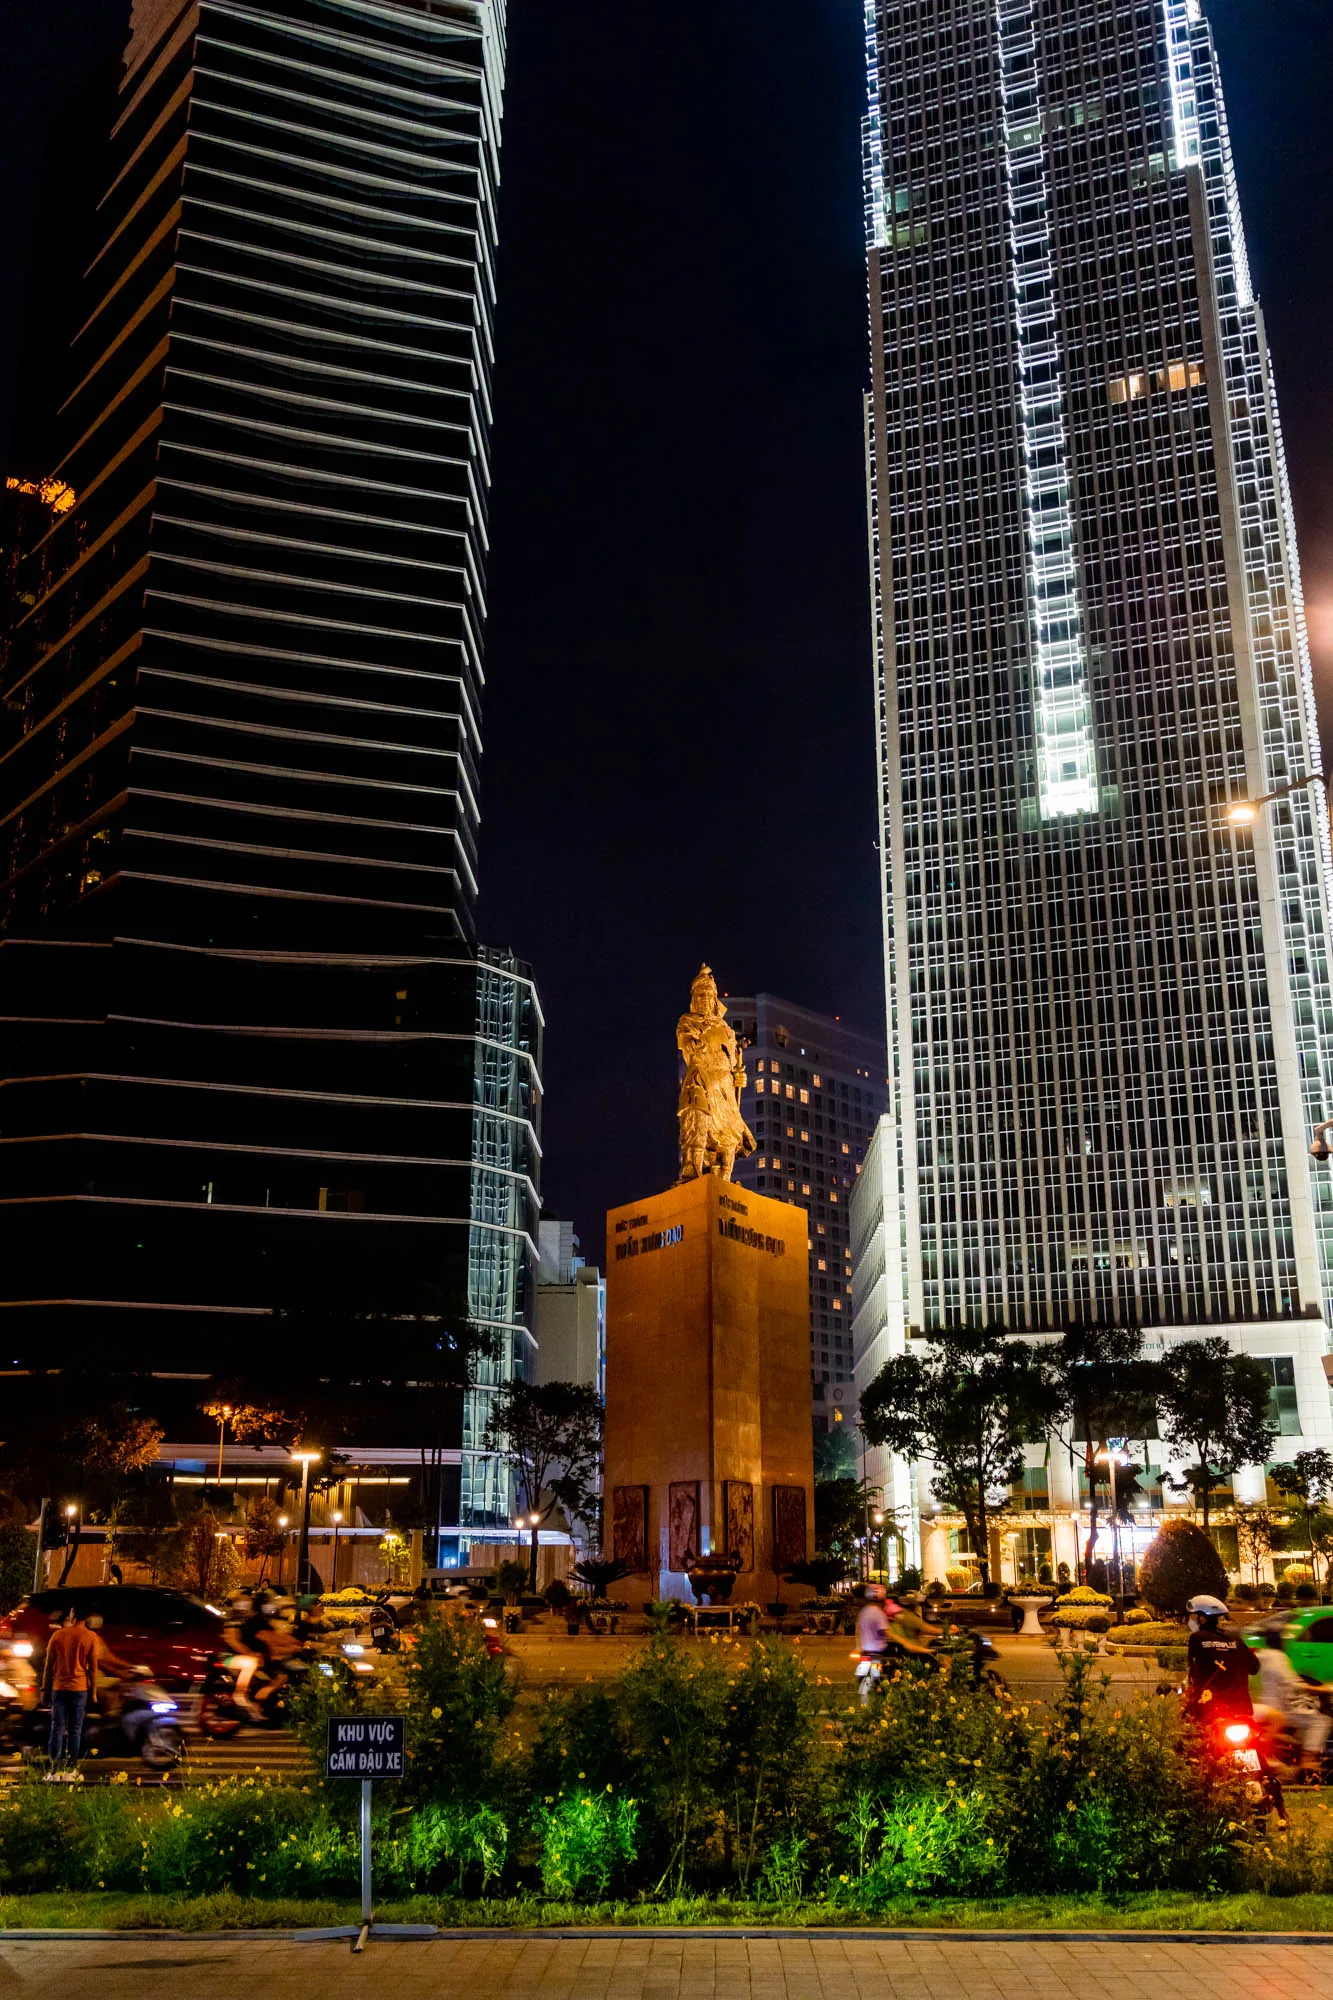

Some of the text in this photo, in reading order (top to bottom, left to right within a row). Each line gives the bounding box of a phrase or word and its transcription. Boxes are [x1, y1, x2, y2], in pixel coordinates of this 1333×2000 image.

[338, 1721, 394, 1744] KHU VỰC
[330, 1746, 401, 1773] CẤM ĐẬU XE
